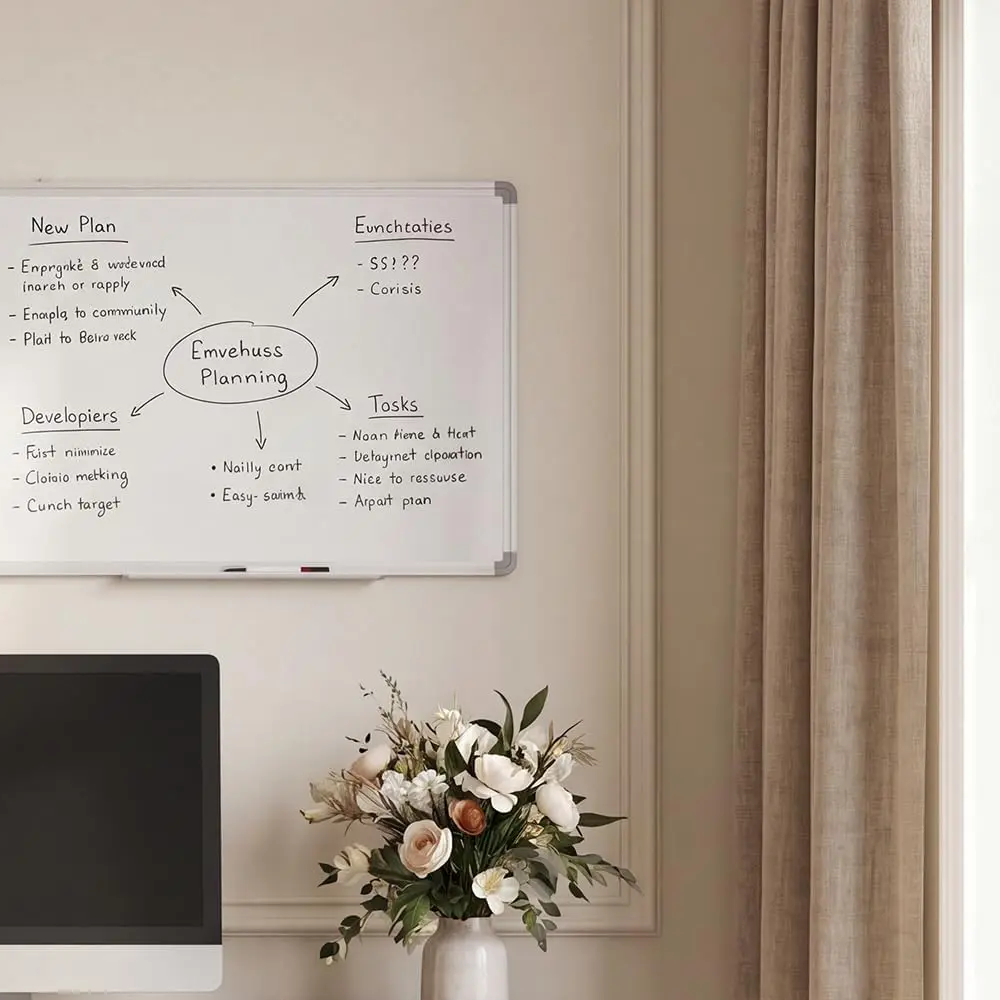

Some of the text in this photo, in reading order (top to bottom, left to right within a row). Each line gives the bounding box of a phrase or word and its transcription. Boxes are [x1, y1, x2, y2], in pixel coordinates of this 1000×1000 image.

[31, 214, 116, 235] New Plan
[71, 281, 85, 291] or
[91, 275, 131, 294] rapply
[370, 281, 422, 296] Corisis
[74, 306, 87, 319] to
[59, 330, 72, 344] to
[191, 339, 284, 360] Emvehuss
[200, 367, 288, 393] Planning
[21, 405, 118, 429] Developiers
[223, 460, 262, 481] Nailly
[388, 471, 403, 485] to
[27, 496, 121, 518] Cunch target
